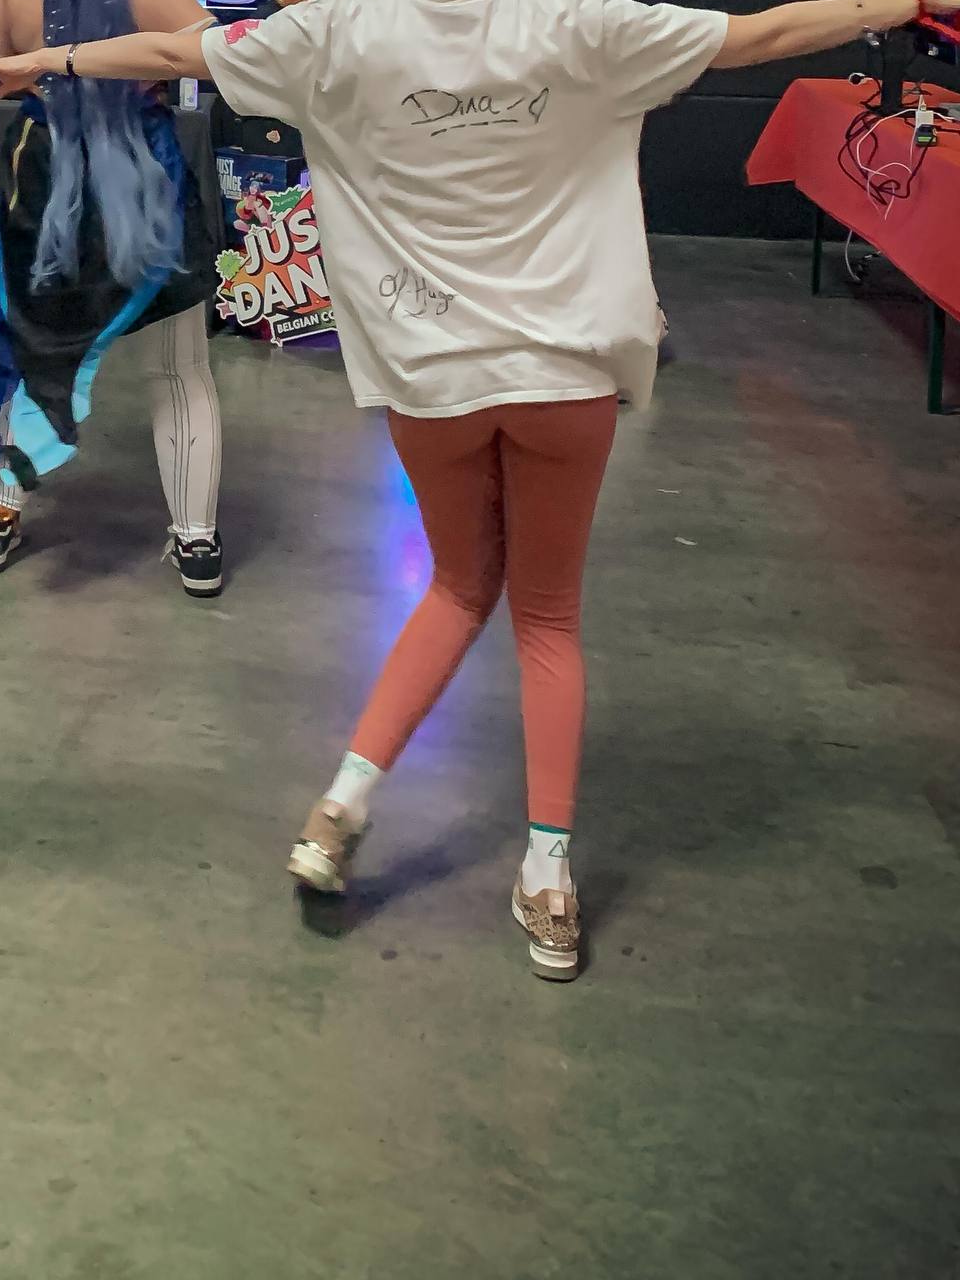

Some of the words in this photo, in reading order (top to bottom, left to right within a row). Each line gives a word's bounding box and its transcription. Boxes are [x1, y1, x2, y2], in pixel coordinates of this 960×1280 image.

[244, 208, 320, 274] JUS
[233, 254, 331, 321] DAN
[276, 313, 320, 334] BELGIAN
